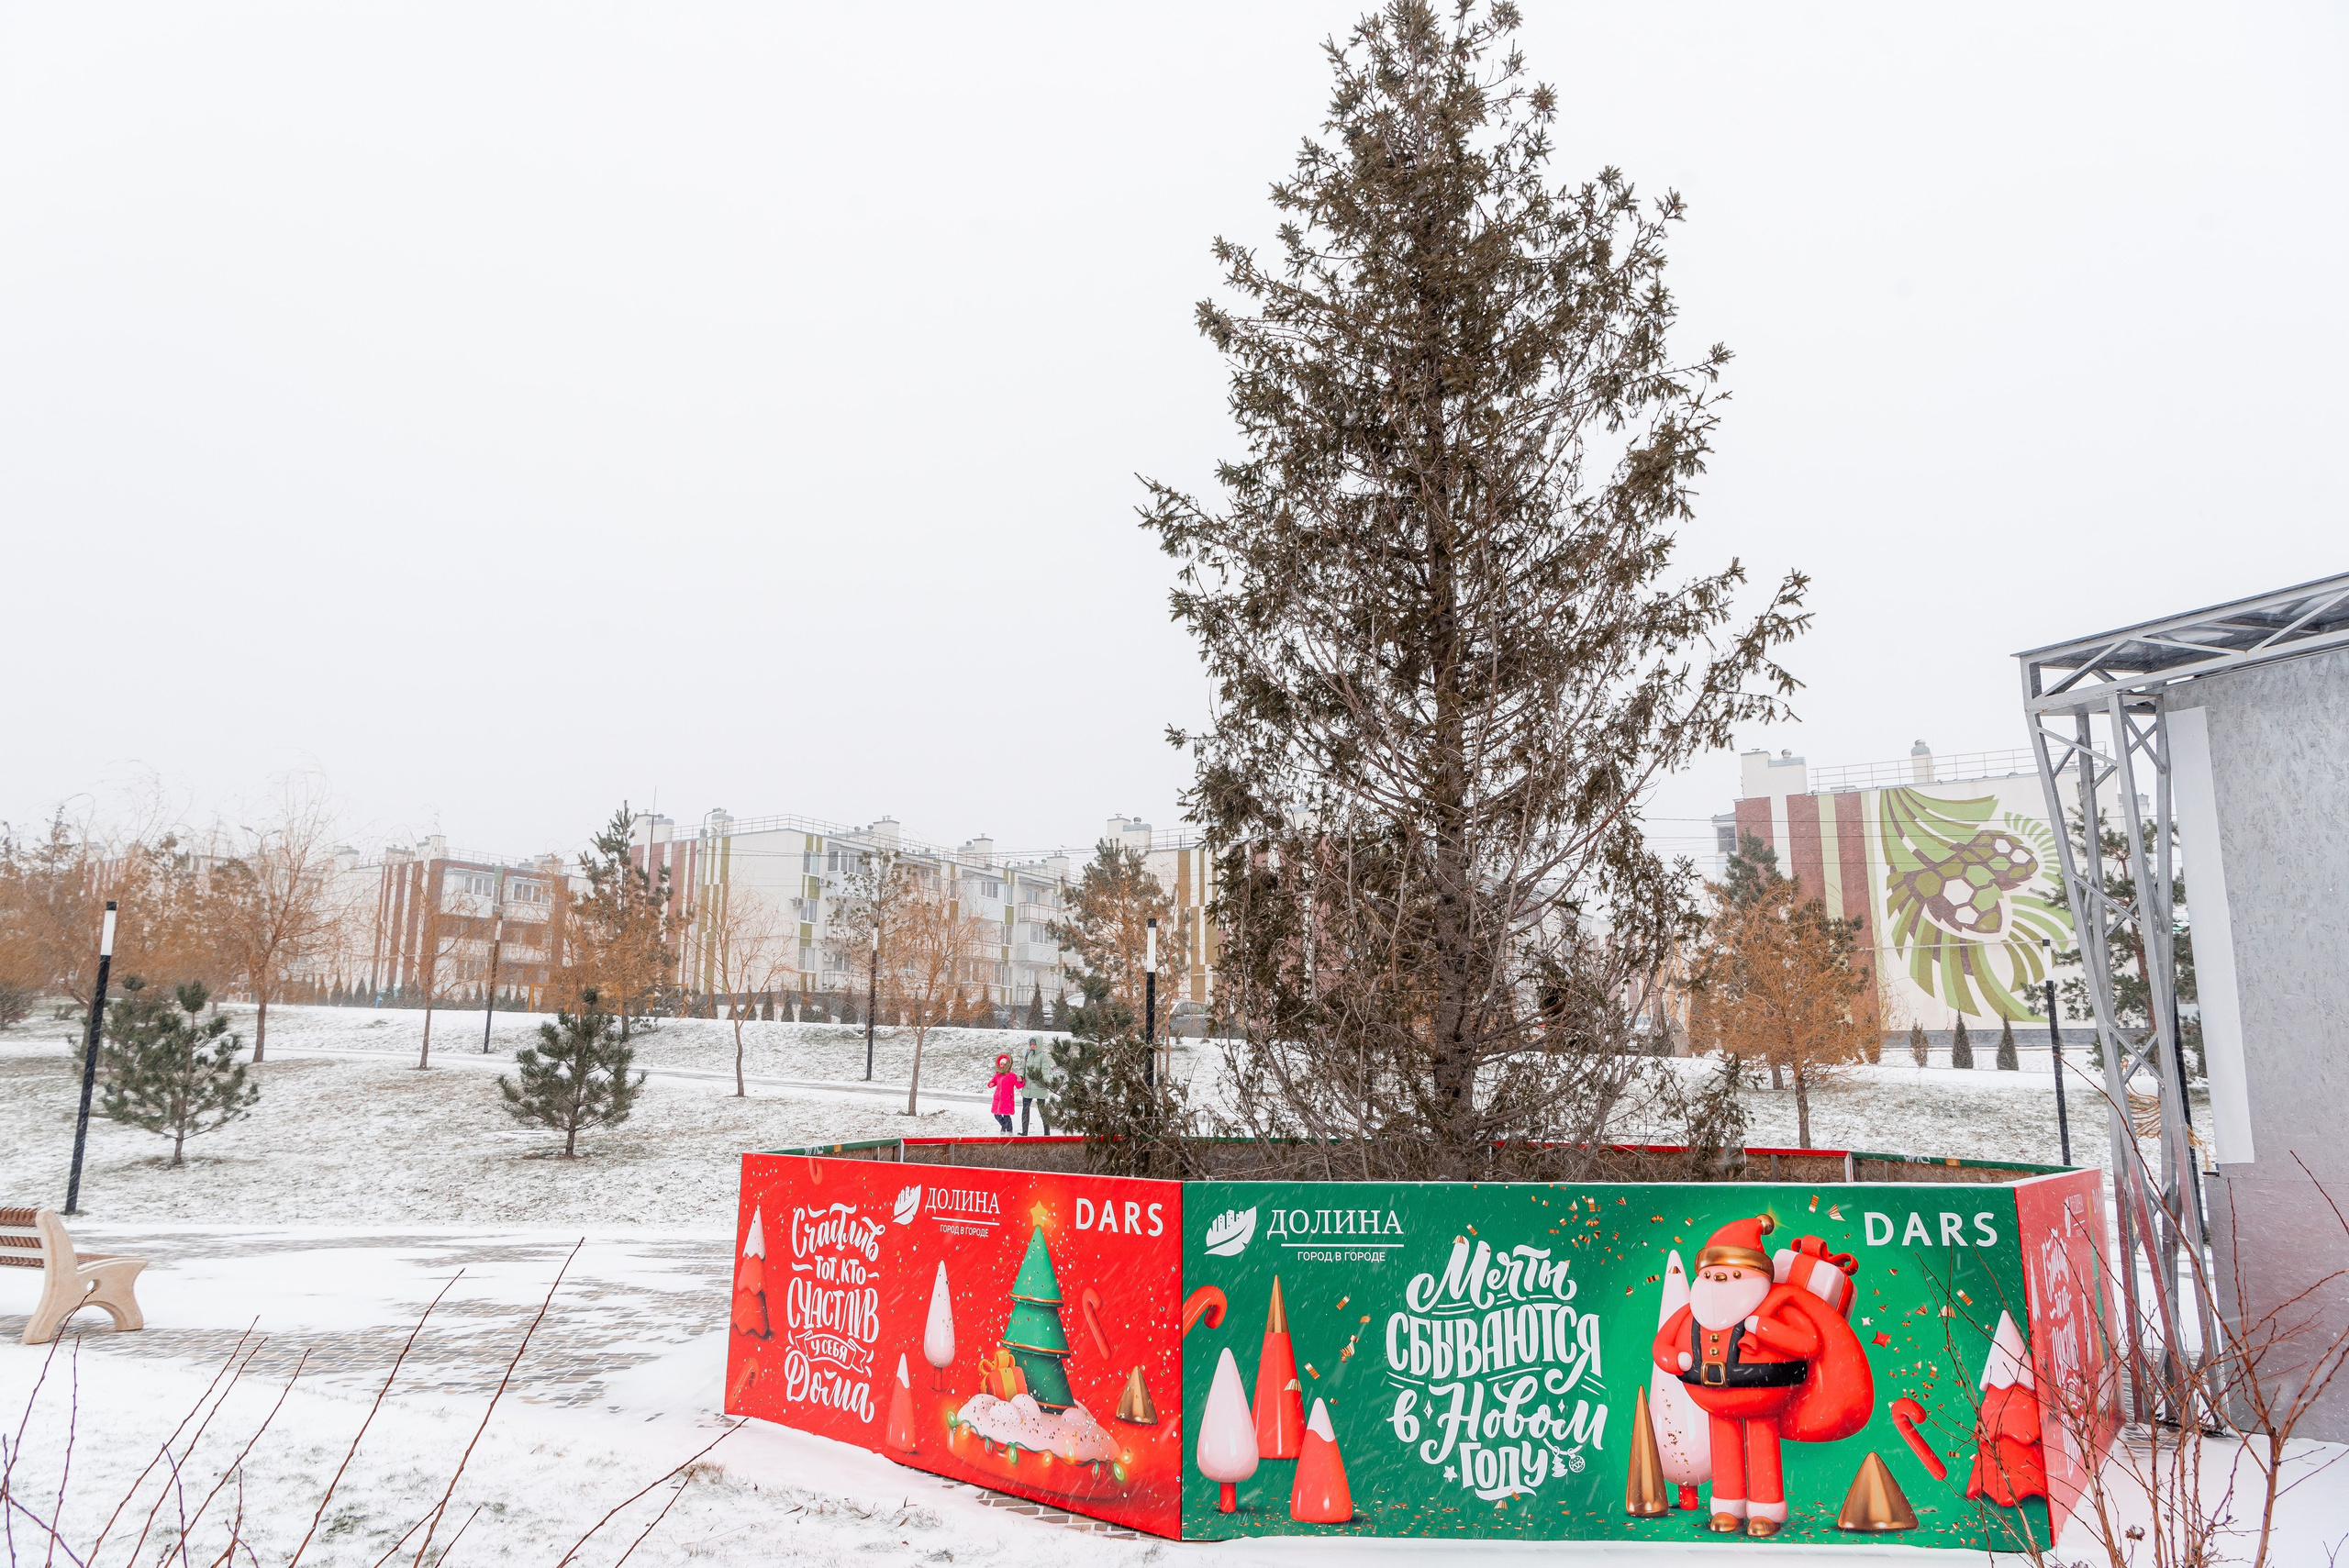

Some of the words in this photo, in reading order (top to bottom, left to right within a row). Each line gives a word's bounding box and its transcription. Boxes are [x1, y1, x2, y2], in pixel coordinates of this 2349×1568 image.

[925, 1187, 1000, 1214] ДОЛИНА
[1075, 1197, 1163, 1237] DARS
[940, 1224, 960, 1236] ГОРОД
[965, 1226, 989, 1238] ГОРОДЕ
[1266, 1209, 1405, 1240] ДОЛИНА
[1864, 1211, 1998, 1248] DARS
[1297, 1251, 1333, 1262] ГОРОД
[1335, 1251, 1342, 1262] В
[1344, 1251, 1386, 1262] ГОРОДЕ
[1406, 1235, 1577, 1313] Мечты
[786, 1276, 880, 1343] СЧАСТЛИВ
[821, 1340, 848, 1363] СЕБЯ
[1386, 1302, 1602, 1395] СБЫВАЮТСЯ
[784, 1350, 875, 1423] Дома
[1419, 1375, 1609, 1465] Новом
